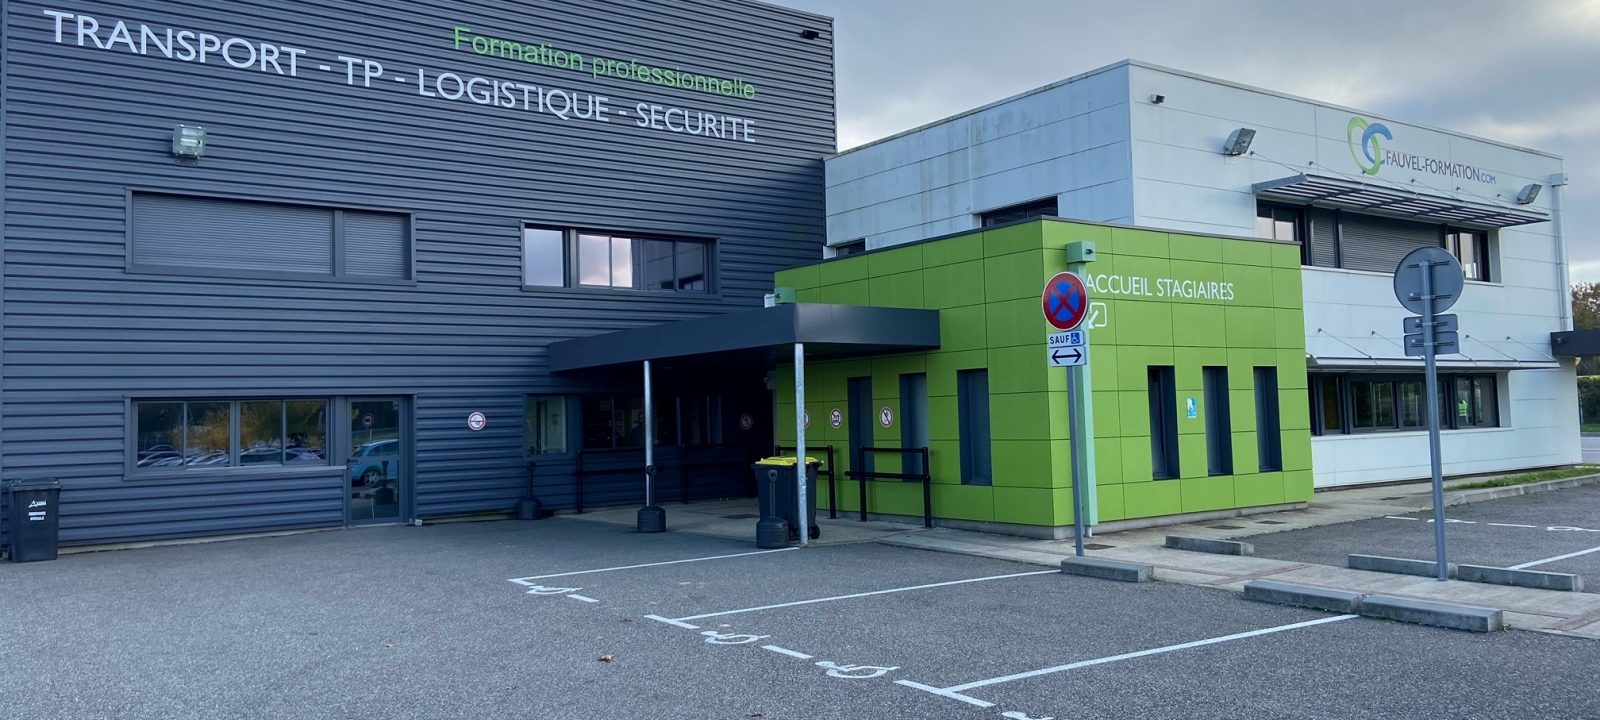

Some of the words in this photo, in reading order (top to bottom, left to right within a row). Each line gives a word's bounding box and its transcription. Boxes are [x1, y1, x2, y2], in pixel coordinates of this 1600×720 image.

[43, 9, 306, 77] TRANSPORT
[338, 55, 384, 88] TP
[418, 68, 609, 122] LOGISTIQUE
[636, 102, 756, 143] SECURITE
[453, 26, 584, 72] Formation
[592, 55, 756, 100] professionnelle
[1086, 273, 1152, 296] ACCUEIL
[1156, 278, 1234, 301] STAGIAIRES
[1049, 333, 1070, 345] SAUF
